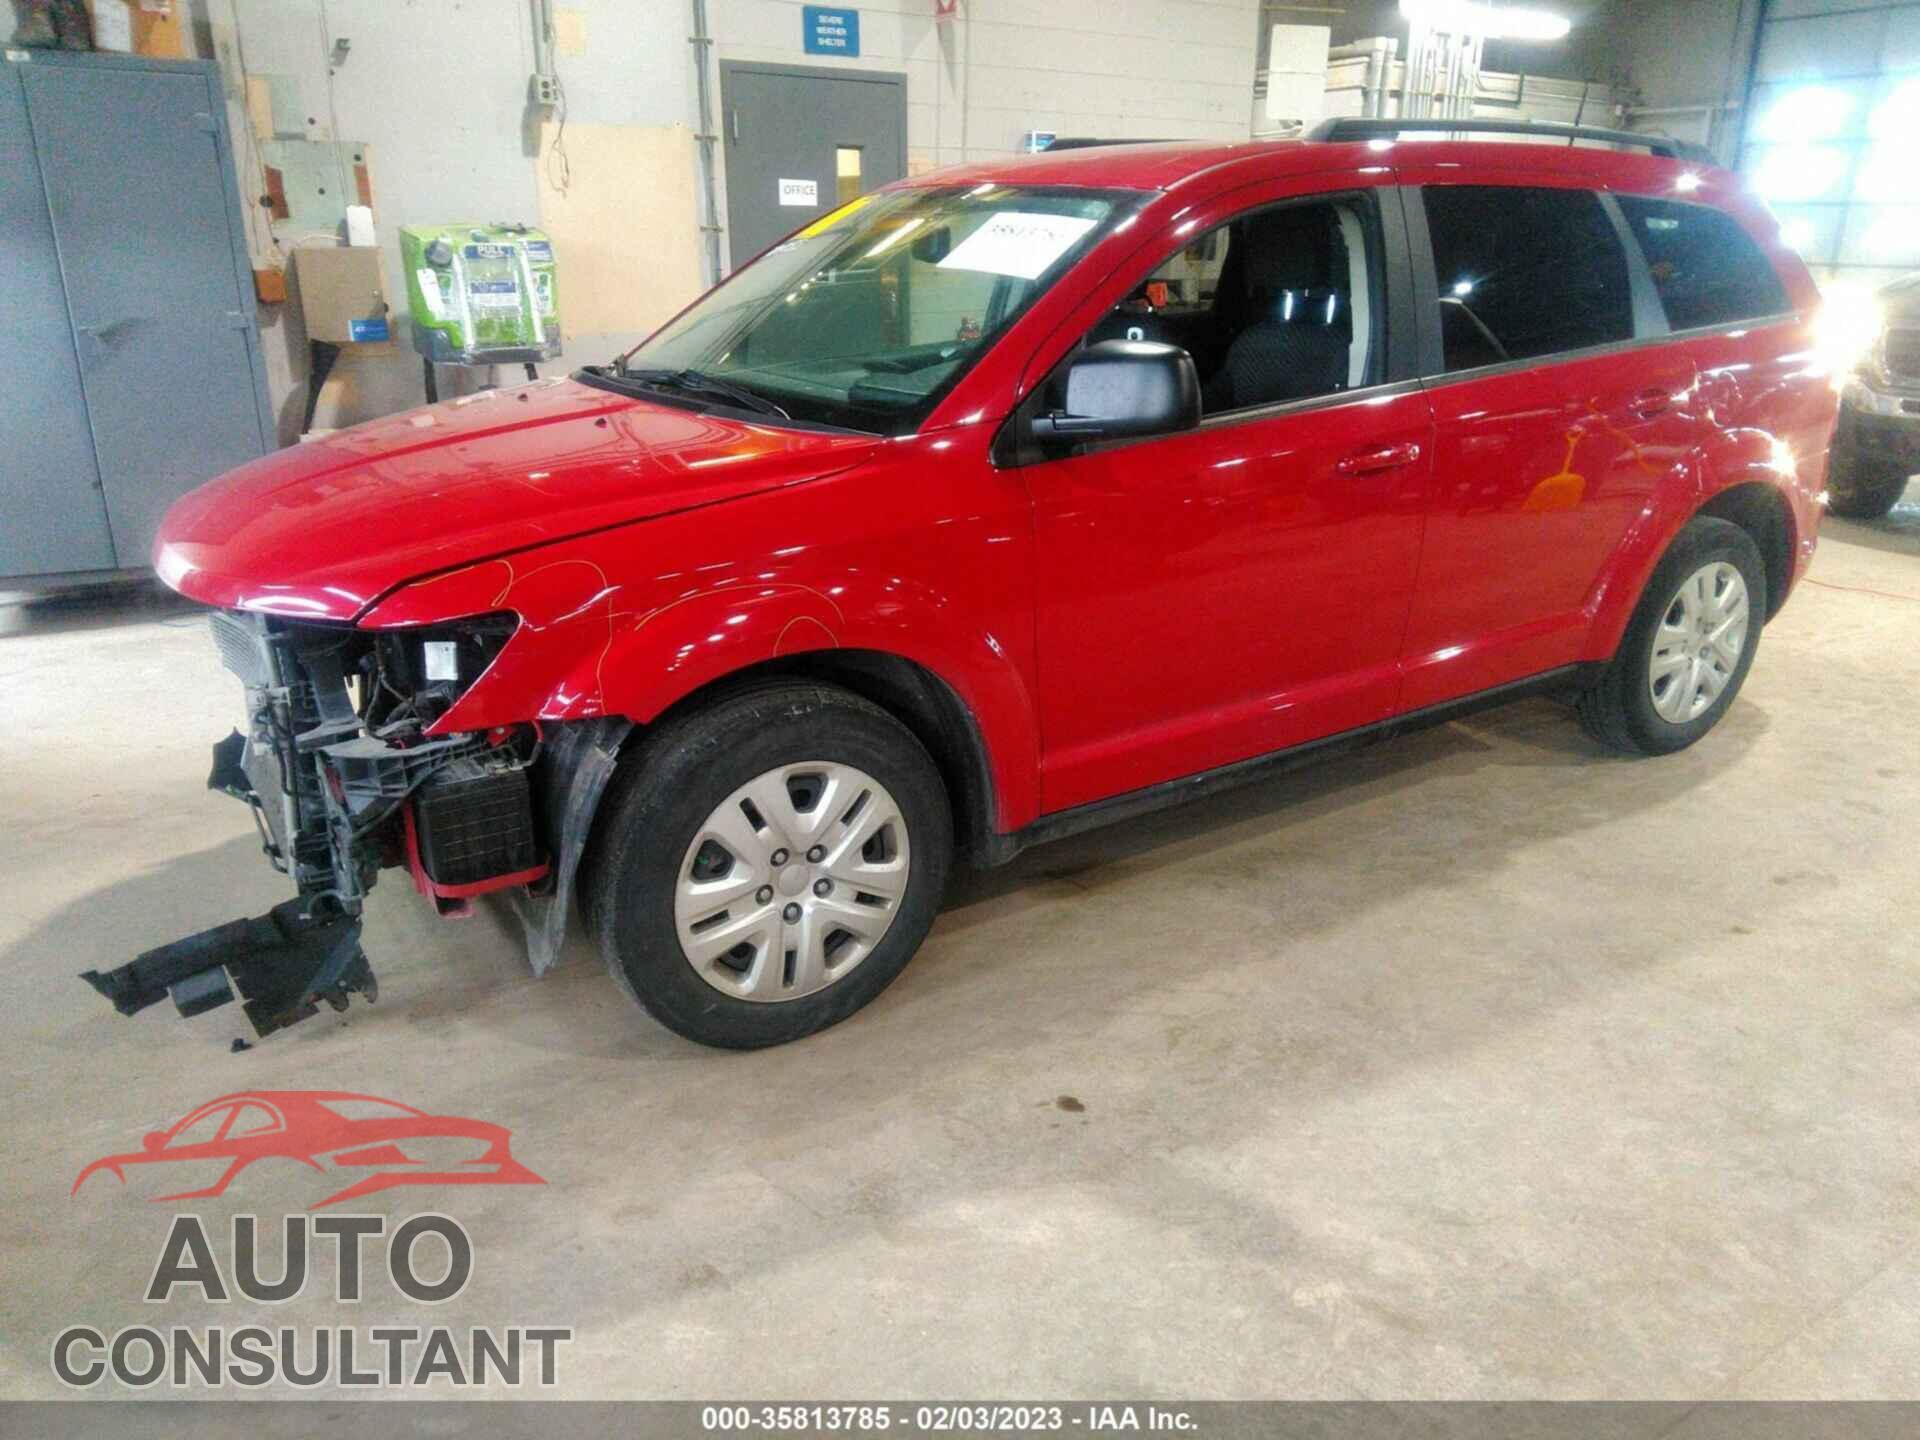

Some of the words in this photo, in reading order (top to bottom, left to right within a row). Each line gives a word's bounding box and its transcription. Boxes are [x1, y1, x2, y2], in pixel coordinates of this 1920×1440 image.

[816, 26, 847, 36] WEATHER
[817, 37, 846, 47] SHELTER
[783, 184, 816, 196] OFFICE
